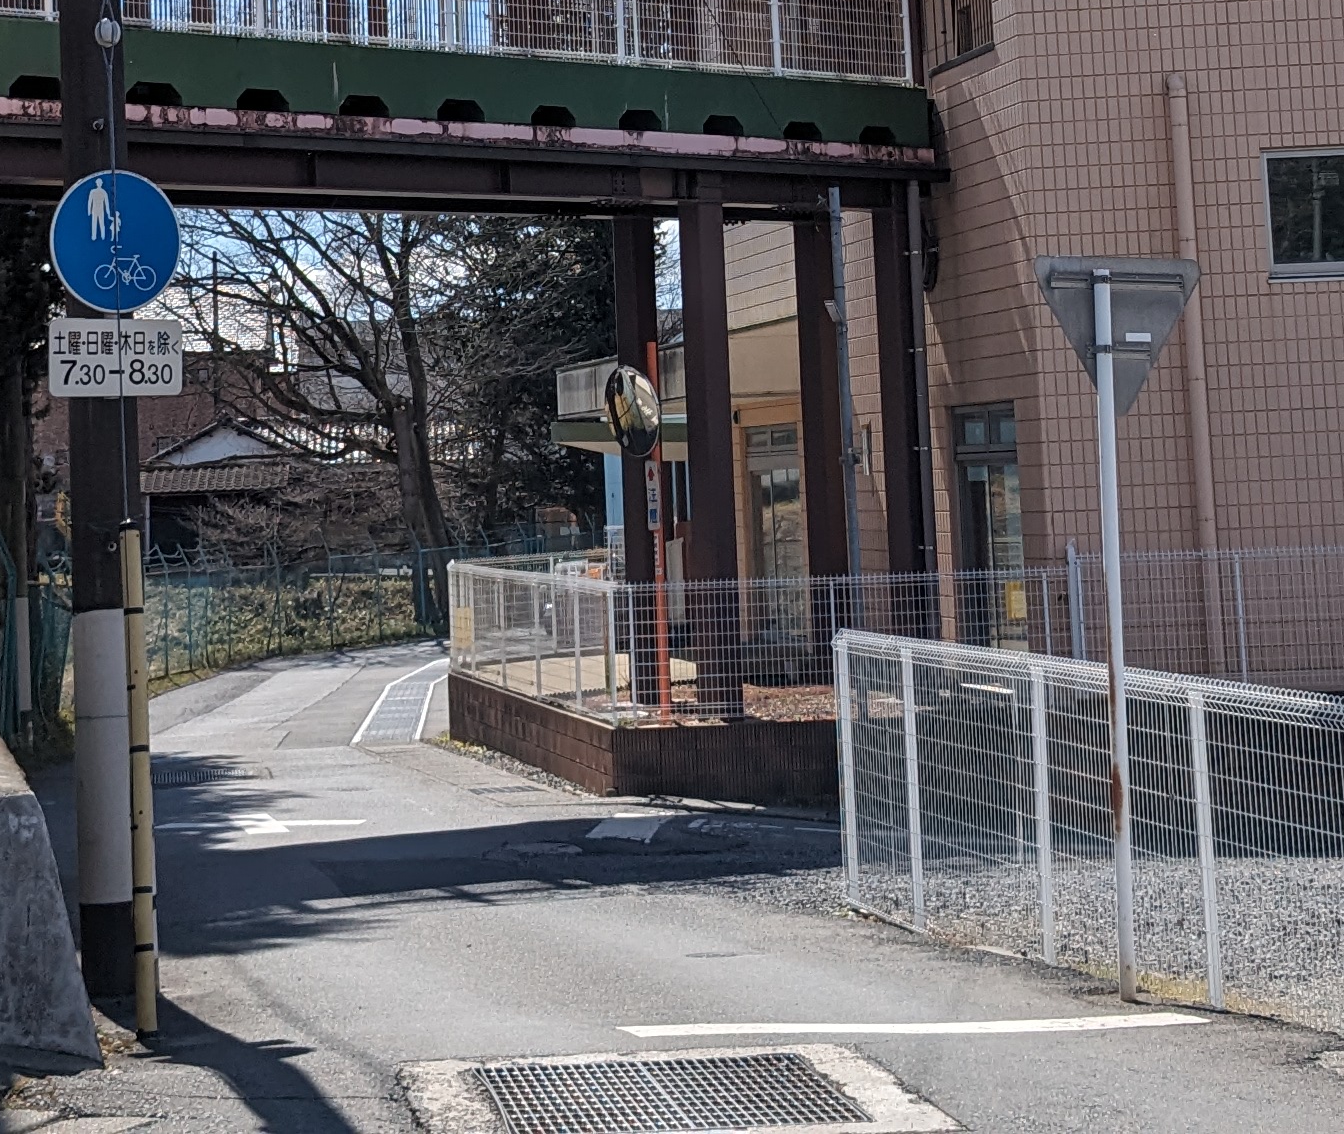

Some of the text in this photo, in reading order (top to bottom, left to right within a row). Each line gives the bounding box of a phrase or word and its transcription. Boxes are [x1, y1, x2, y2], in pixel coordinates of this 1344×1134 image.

[53, 331, 178, 355] 土曜・日曜・休日を除く
